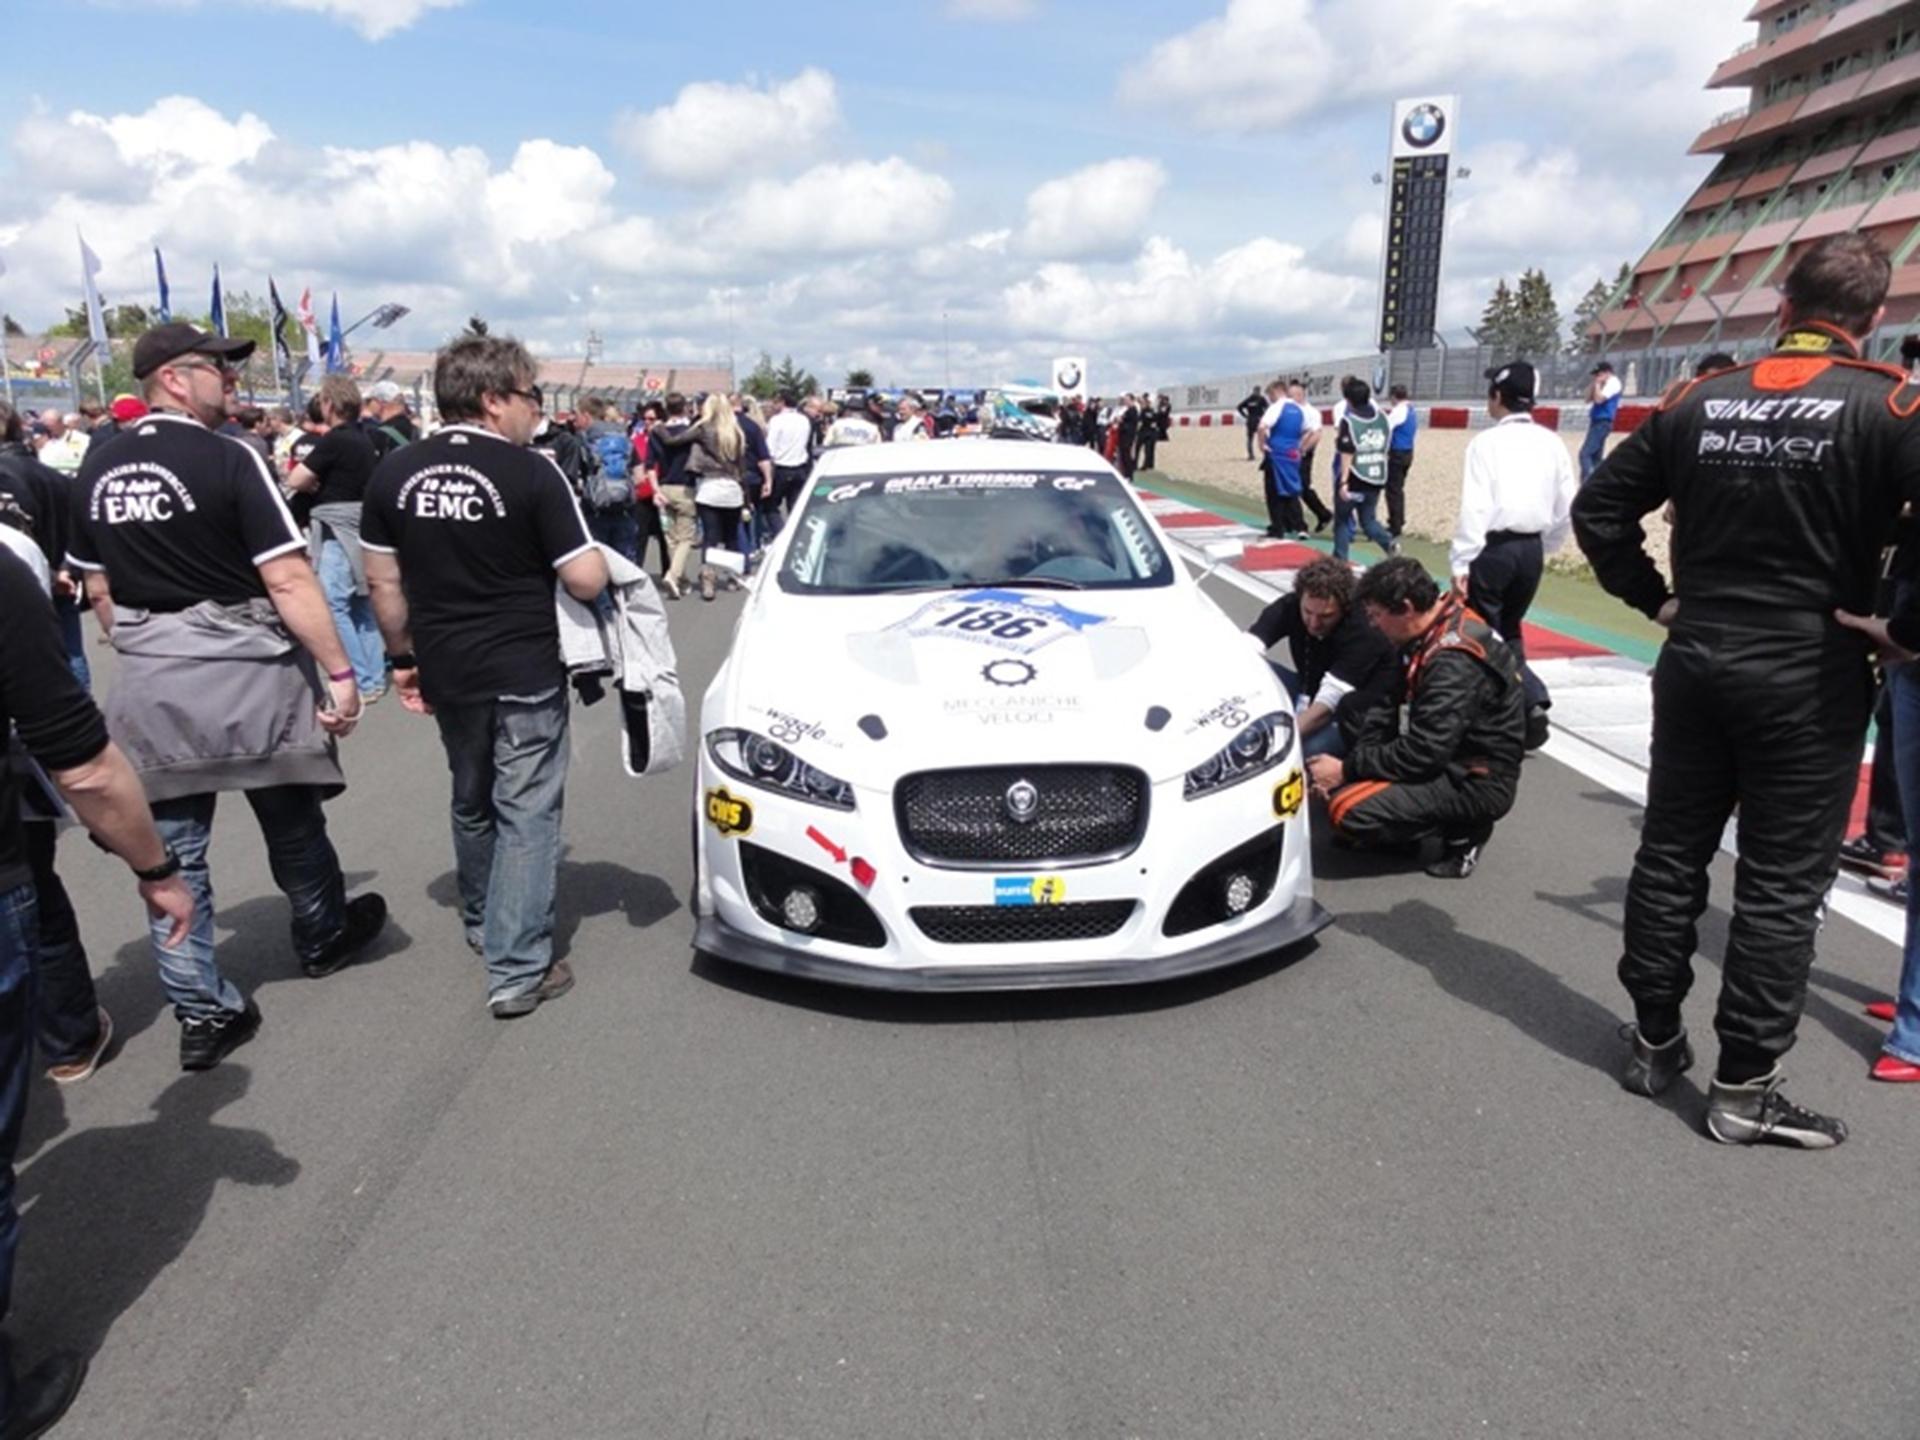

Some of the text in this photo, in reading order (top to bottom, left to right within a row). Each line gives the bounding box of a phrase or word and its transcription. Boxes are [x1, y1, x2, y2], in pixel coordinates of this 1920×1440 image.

[1703, 397, 1845, 421] GINETTA
[884, 475, 942, 491] GRAN
[948, 474, 1039, 488] TURISMO
[105, 493, 173, 524] EMC
[416, 491, 484, 521] EMC
[935, 606, 1049, 639] 186
[943, 695, 1081, 711] MECCANICHE
[978, 711, 1055, 726] VELOCI
